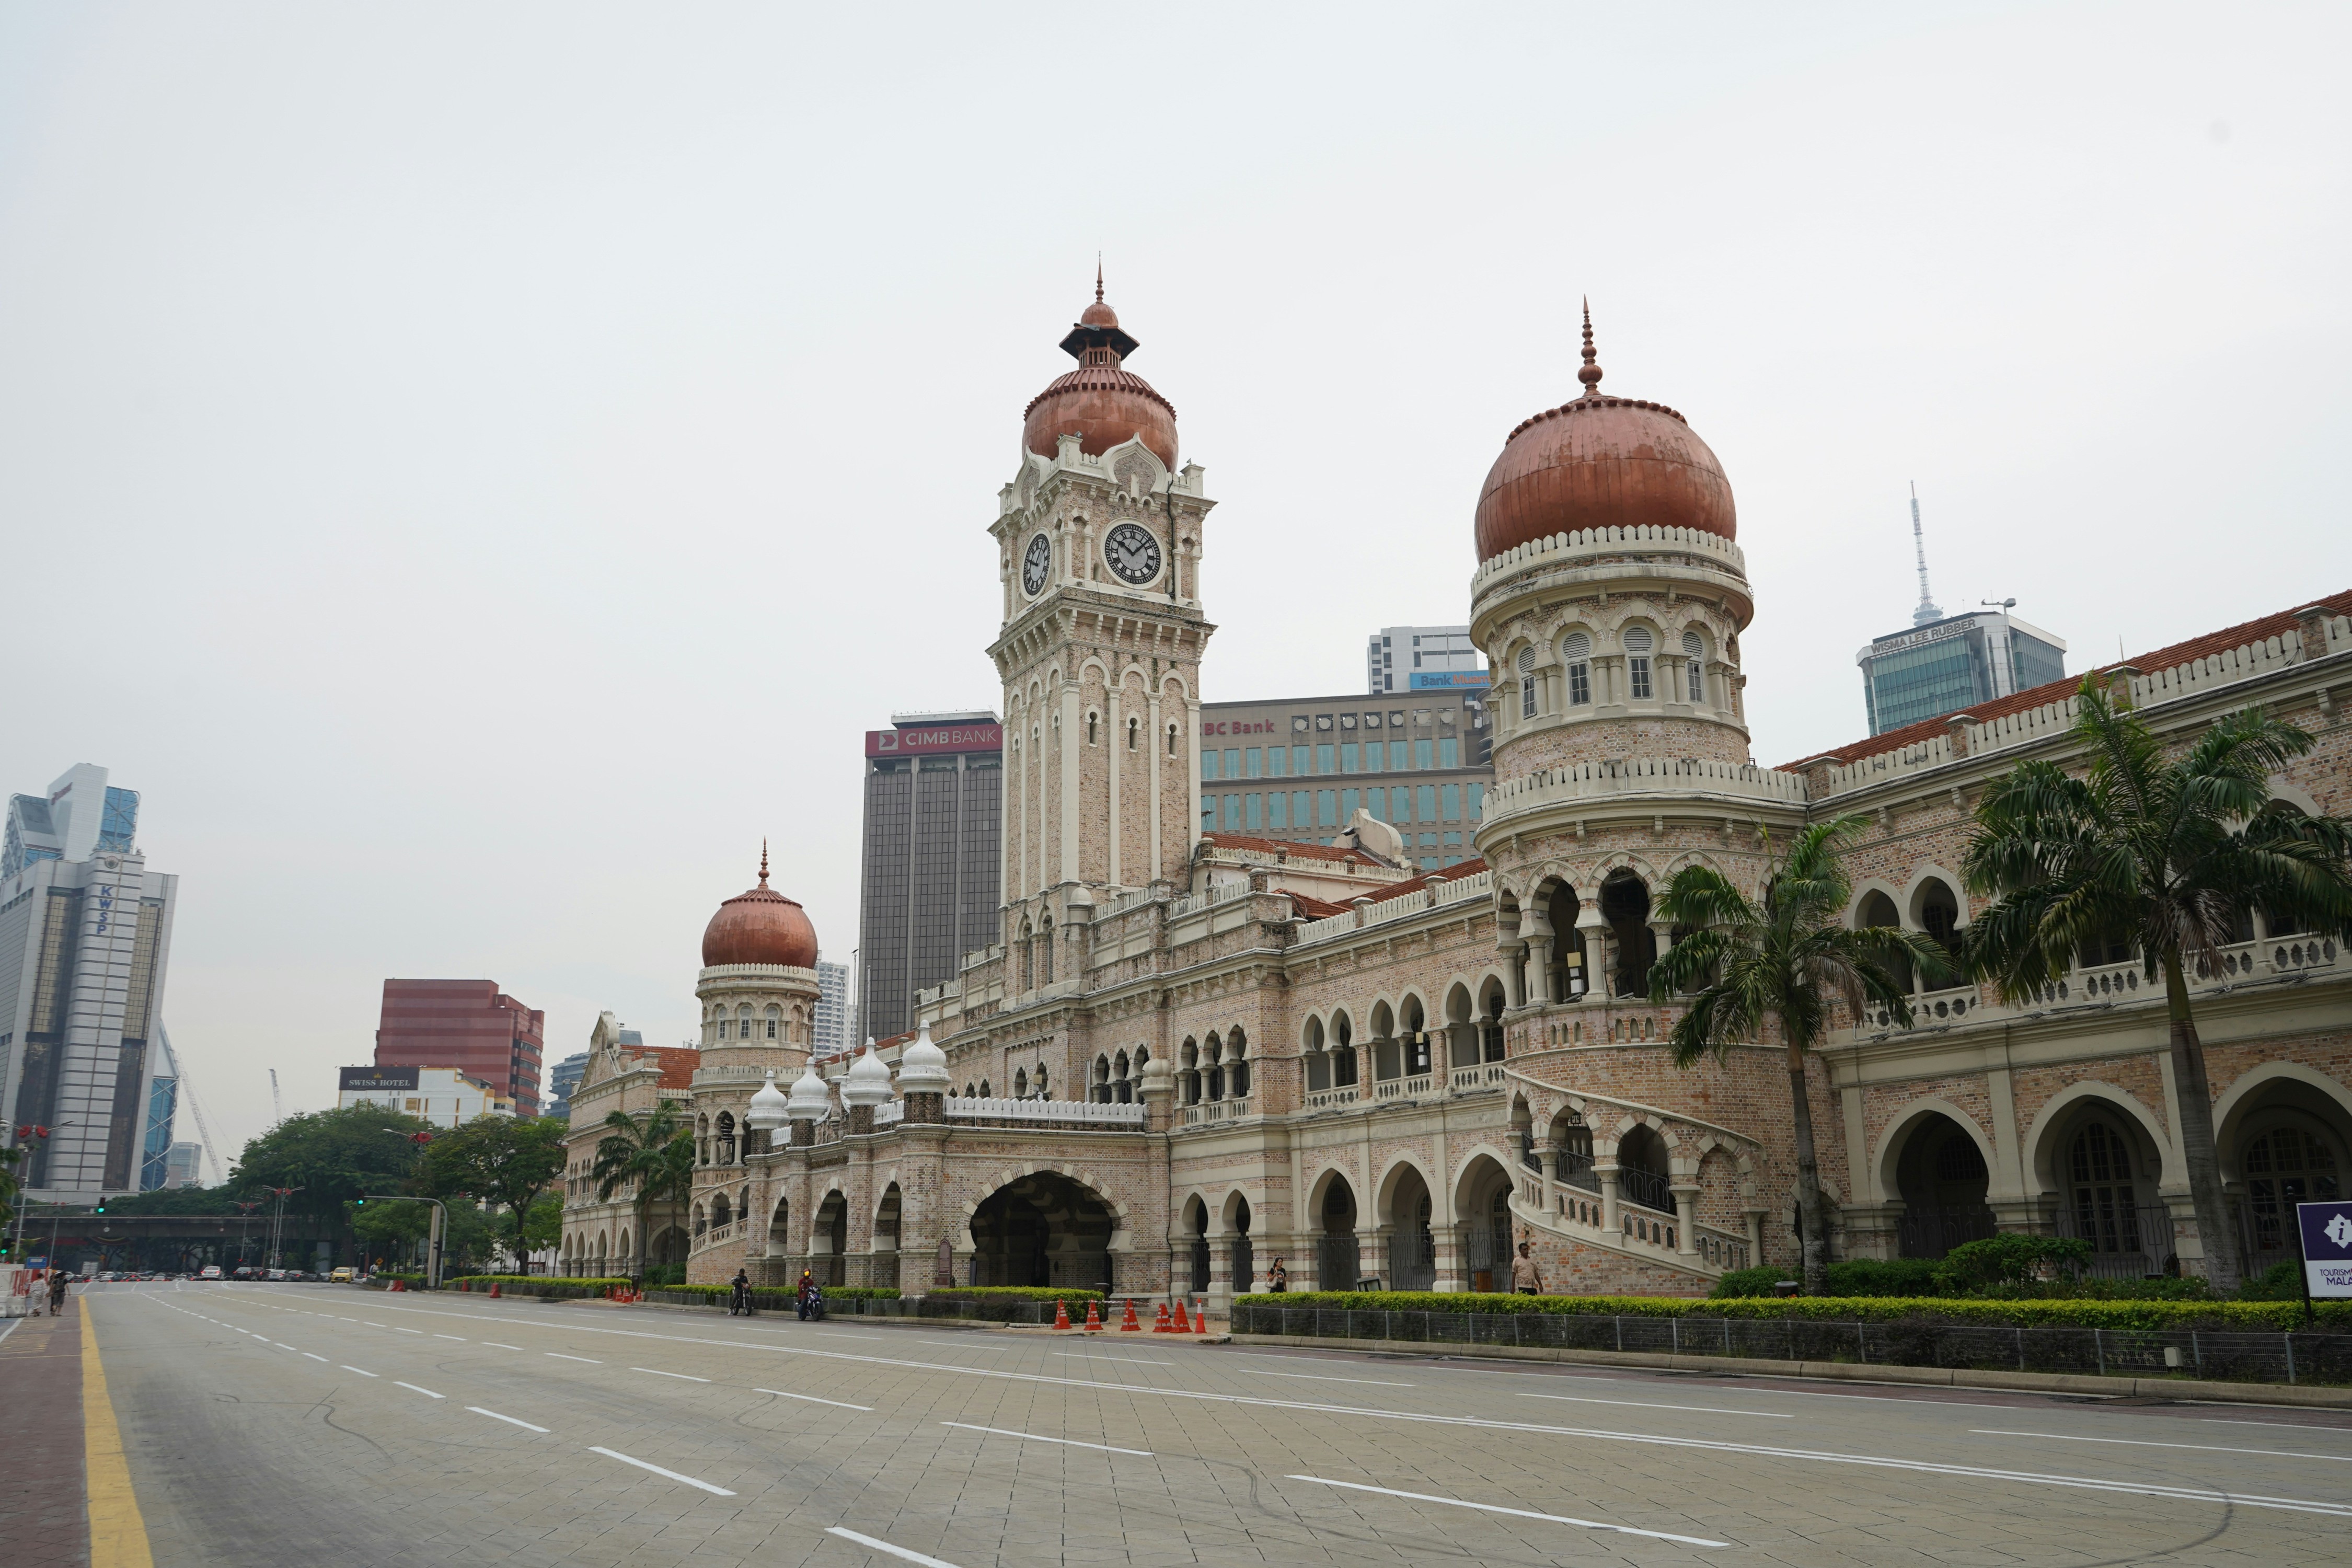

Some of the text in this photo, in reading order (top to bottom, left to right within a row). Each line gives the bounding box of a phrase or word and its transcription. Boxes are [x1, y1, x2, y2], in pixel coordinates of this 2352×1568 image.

[1871, 619, 1976, 654] WISMA LEE RUBBER
[1421, 674, 1490, 686] Bank Muam
[1200, 719, 1274, 736] BC Bank
[906, 729, 997, 745] CIMB BANK
[96, 886, 113, 934] KWSP
